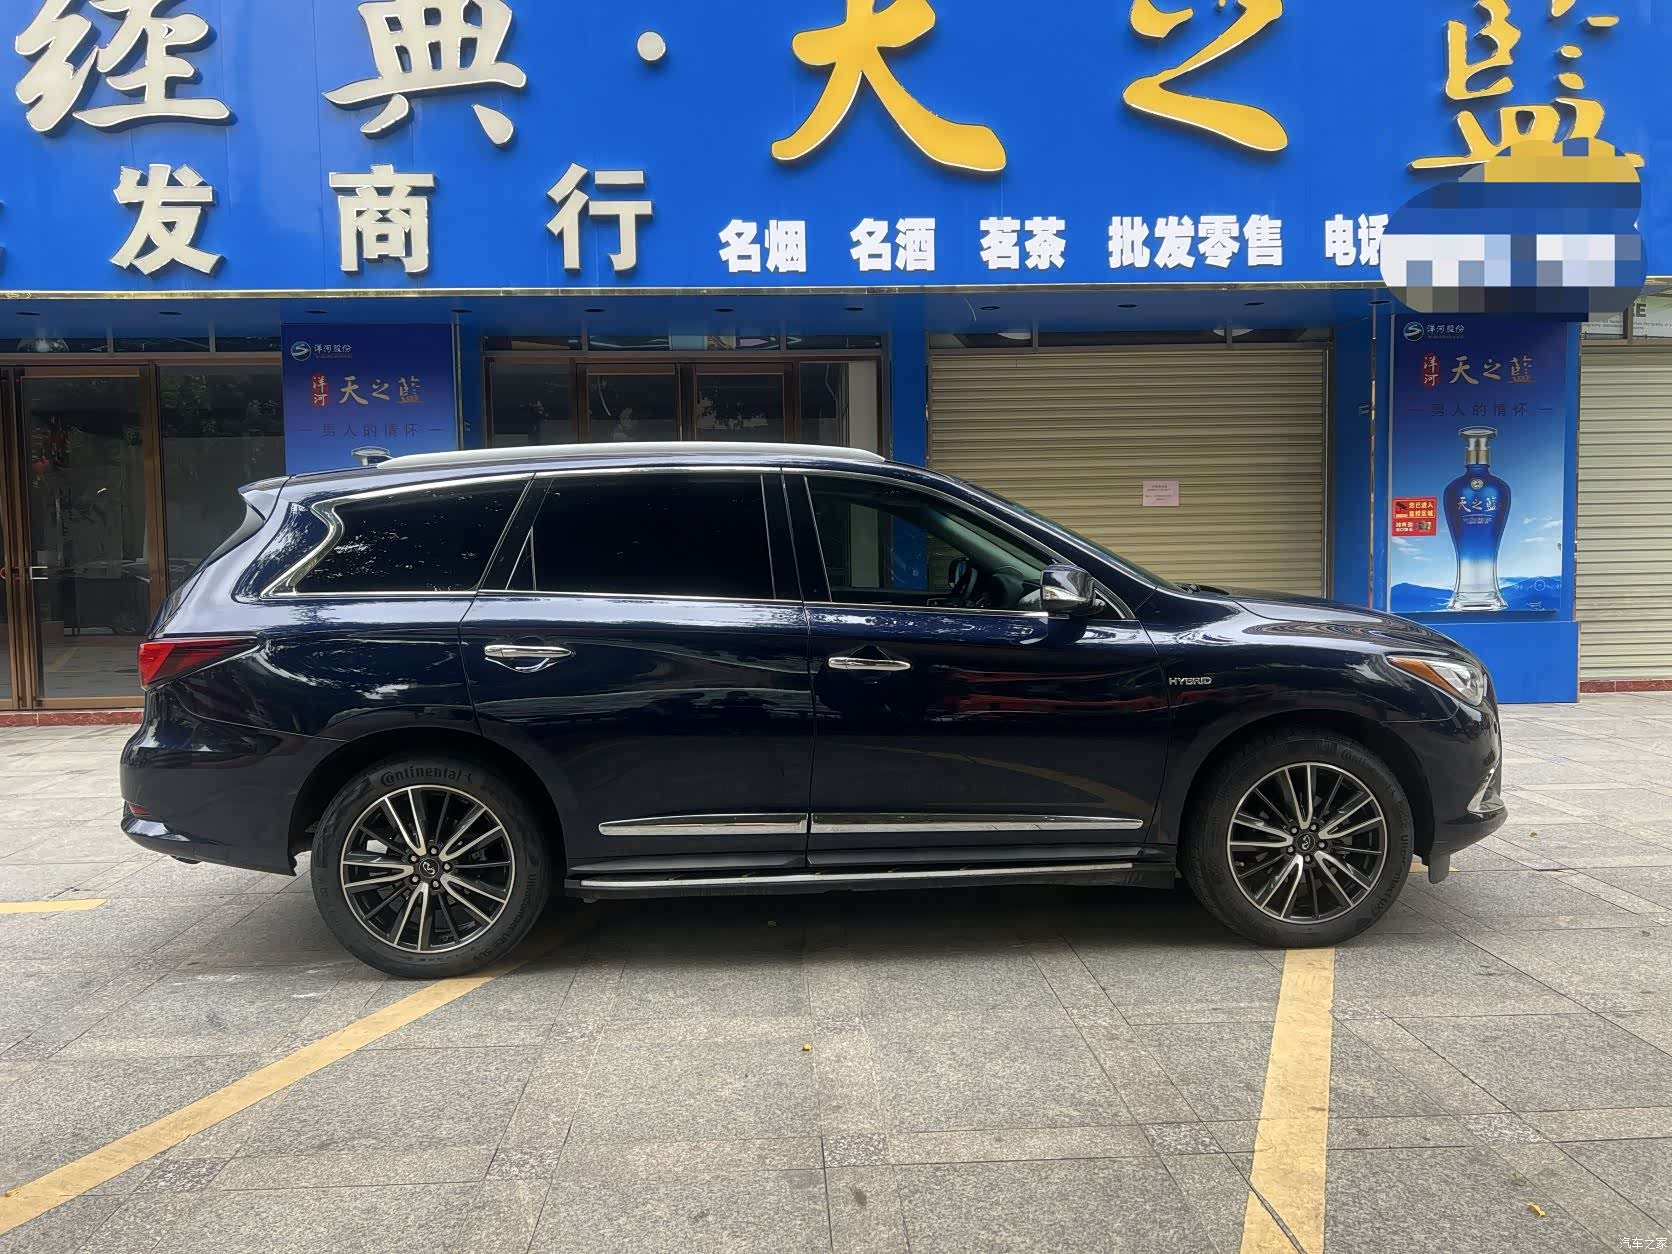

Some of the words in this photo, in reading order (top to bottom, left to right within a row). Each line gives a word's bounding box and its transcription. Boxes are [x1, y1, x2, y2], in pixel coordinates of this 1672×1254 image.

[0, 163, 653, 274] 发商行
[718, 219, 807, 273] 名烟
[850, 217, 936, 272] 名酒
[979, 216, 1066, 271] 茗茶
[1108, 215, 1284, 269] 批发零售
[1426, 323, 1465, 335] 洋河股份
[313, 343, 352, 354] 洋河股份
[1423, 356, 1438, 387] 洋河
[312, 375, 329, 407] 洋河
[1168, 676, 1213, 686] HYBRID
[380, 765, 462, 787] Continental
